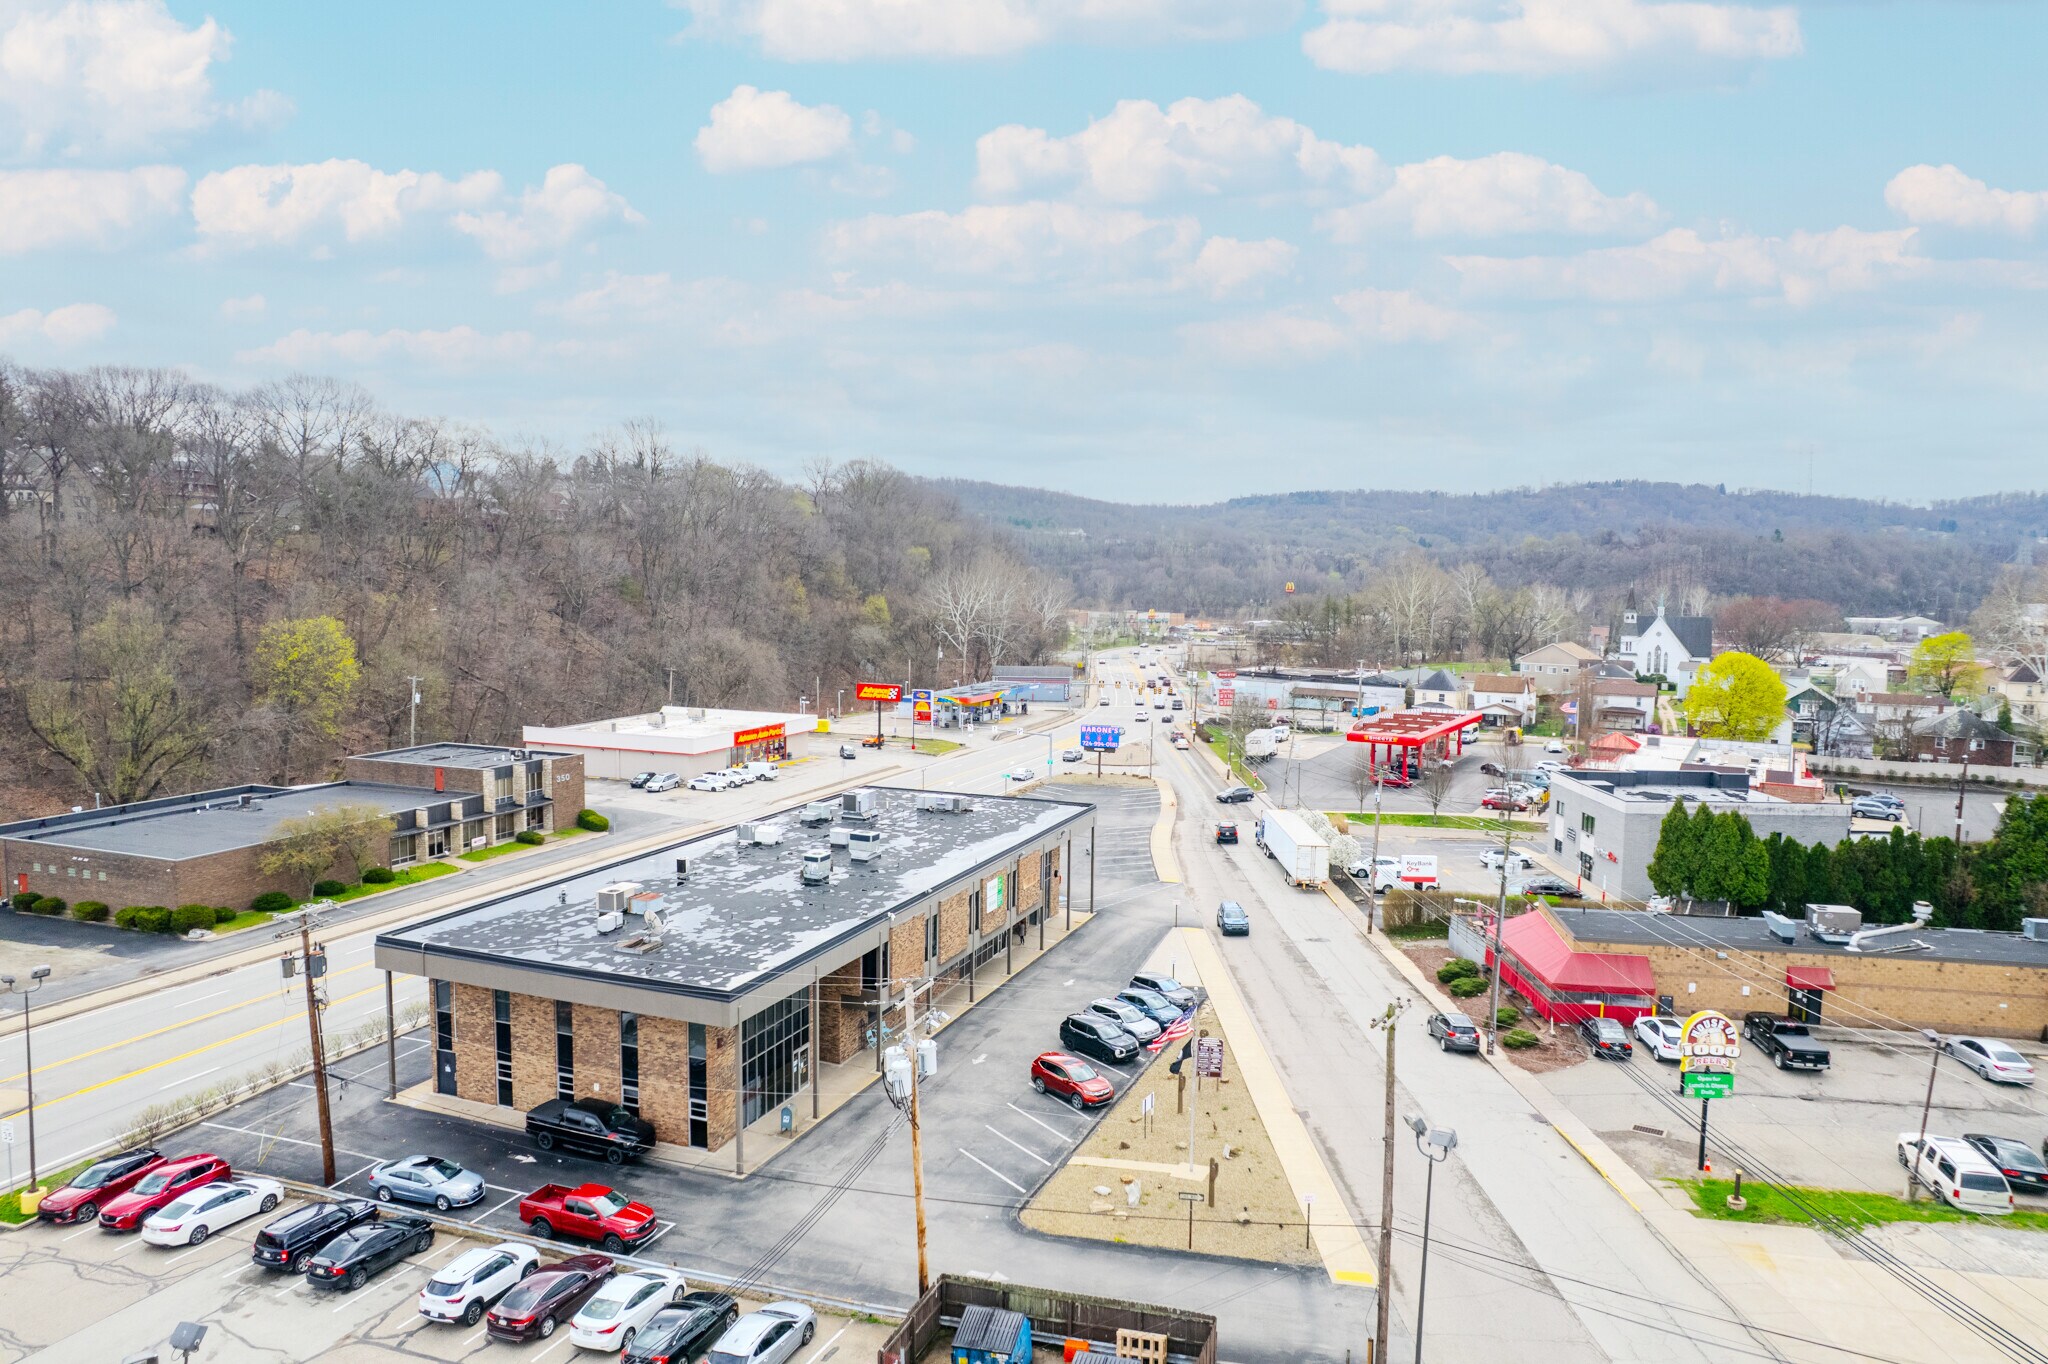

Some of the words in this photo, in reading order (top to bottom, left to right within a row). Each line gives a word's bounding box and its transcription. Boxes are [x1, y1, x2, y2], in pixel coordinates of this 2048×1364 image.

[556, 773, 570, 783] 350
[1690, 1018, 1725, 1038] HOUSE
[1724, 1026, 1737, 1040] OF
[1683, 1044, 1741, 1058] 1000
[1696, 1057, 1728, 1066] BEERS
